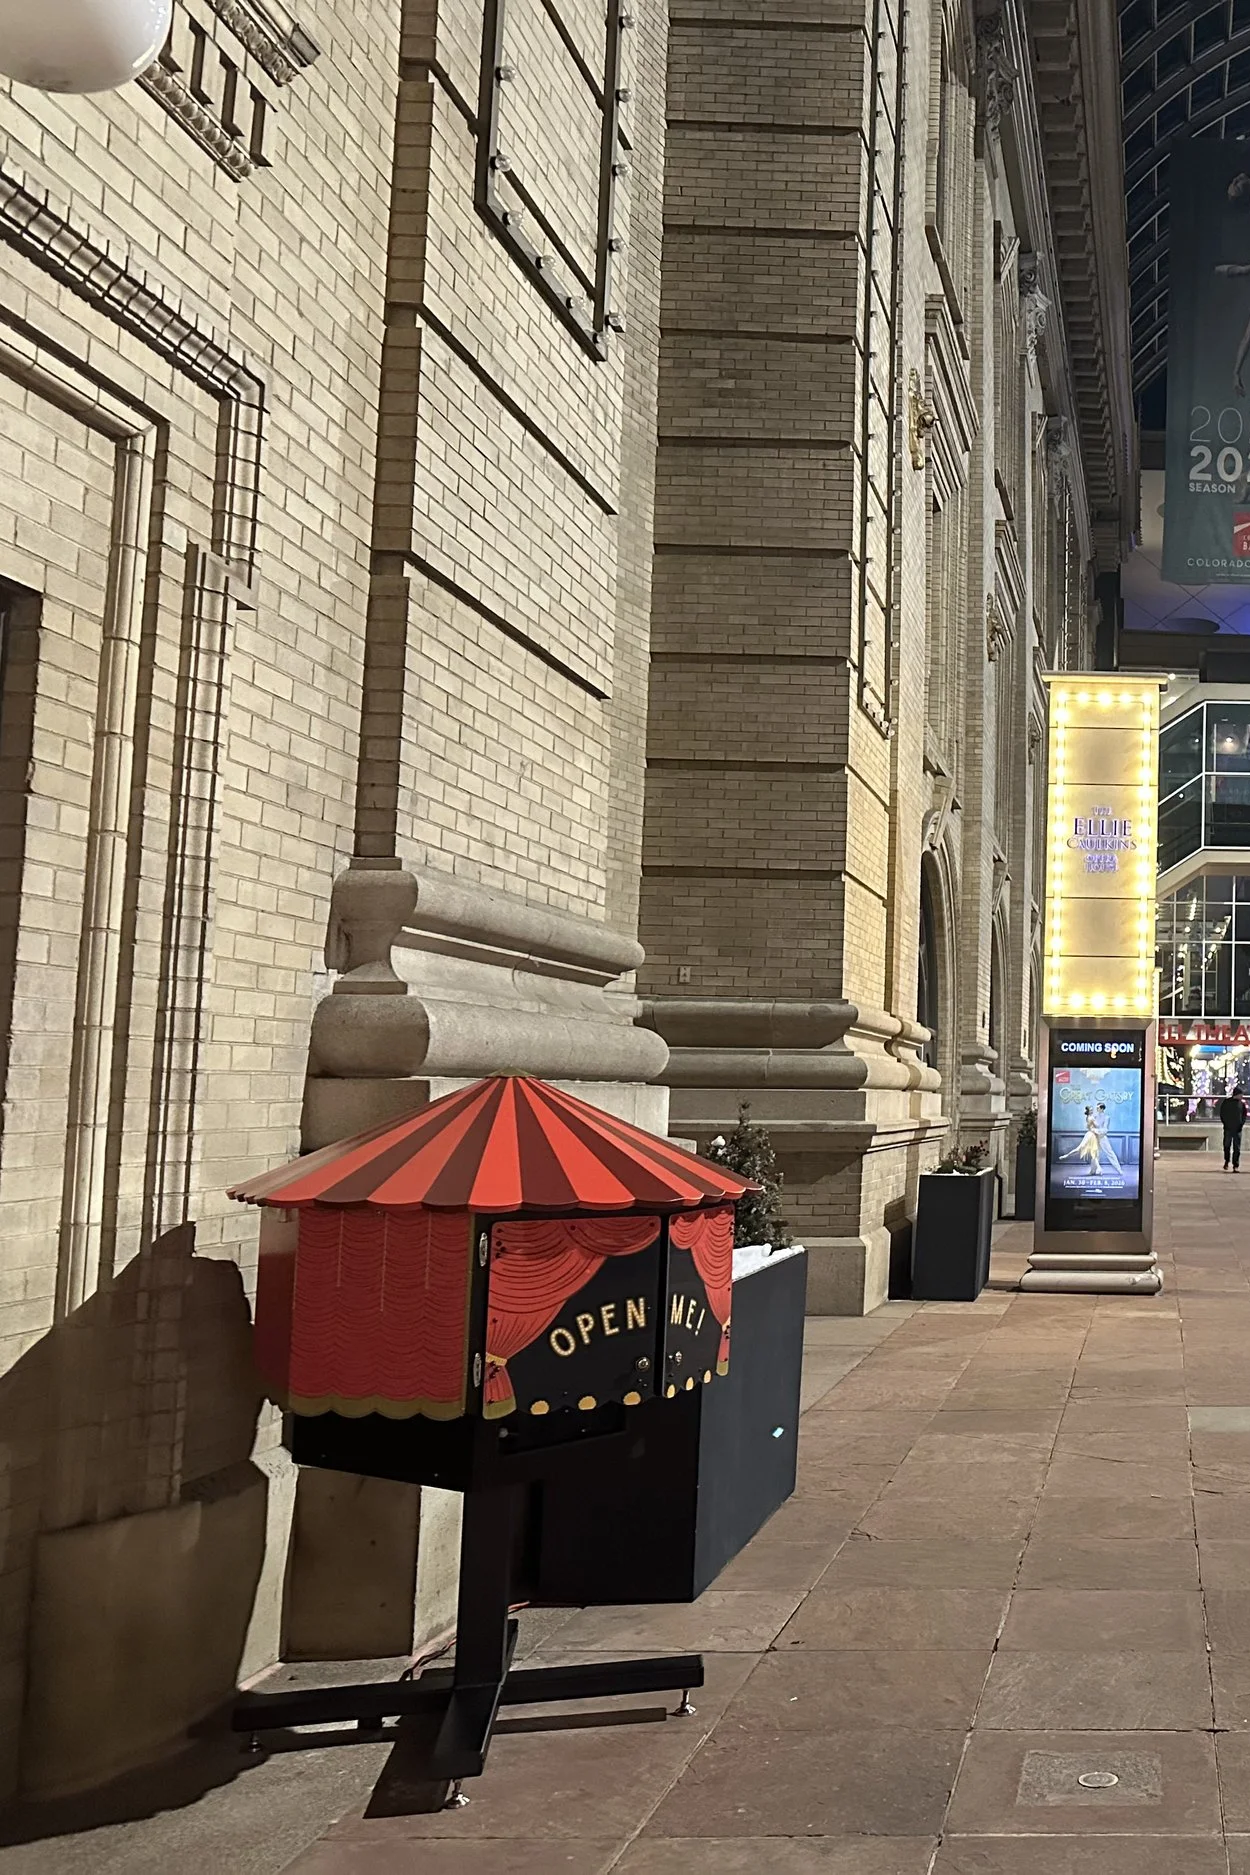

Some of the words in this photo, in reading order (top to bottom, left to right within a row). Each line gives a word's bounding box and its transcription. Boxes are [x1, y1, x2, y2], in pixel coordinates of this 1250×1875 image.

[1189, 482, 1236, 493] SEASON
[1073, 817, 1132, 836] ELLIE
[1066, 837, 1137, 850] CAULKINS
[1061, 1042, 1102, 1052] COMING
[1104, 1042, 1135, 1053] SOON
[1095, 1089, 1134, 1104] GATSBY
[550, 1297, 646, 1356] OPEN
[671, 1293, 705, 1336] ME!
